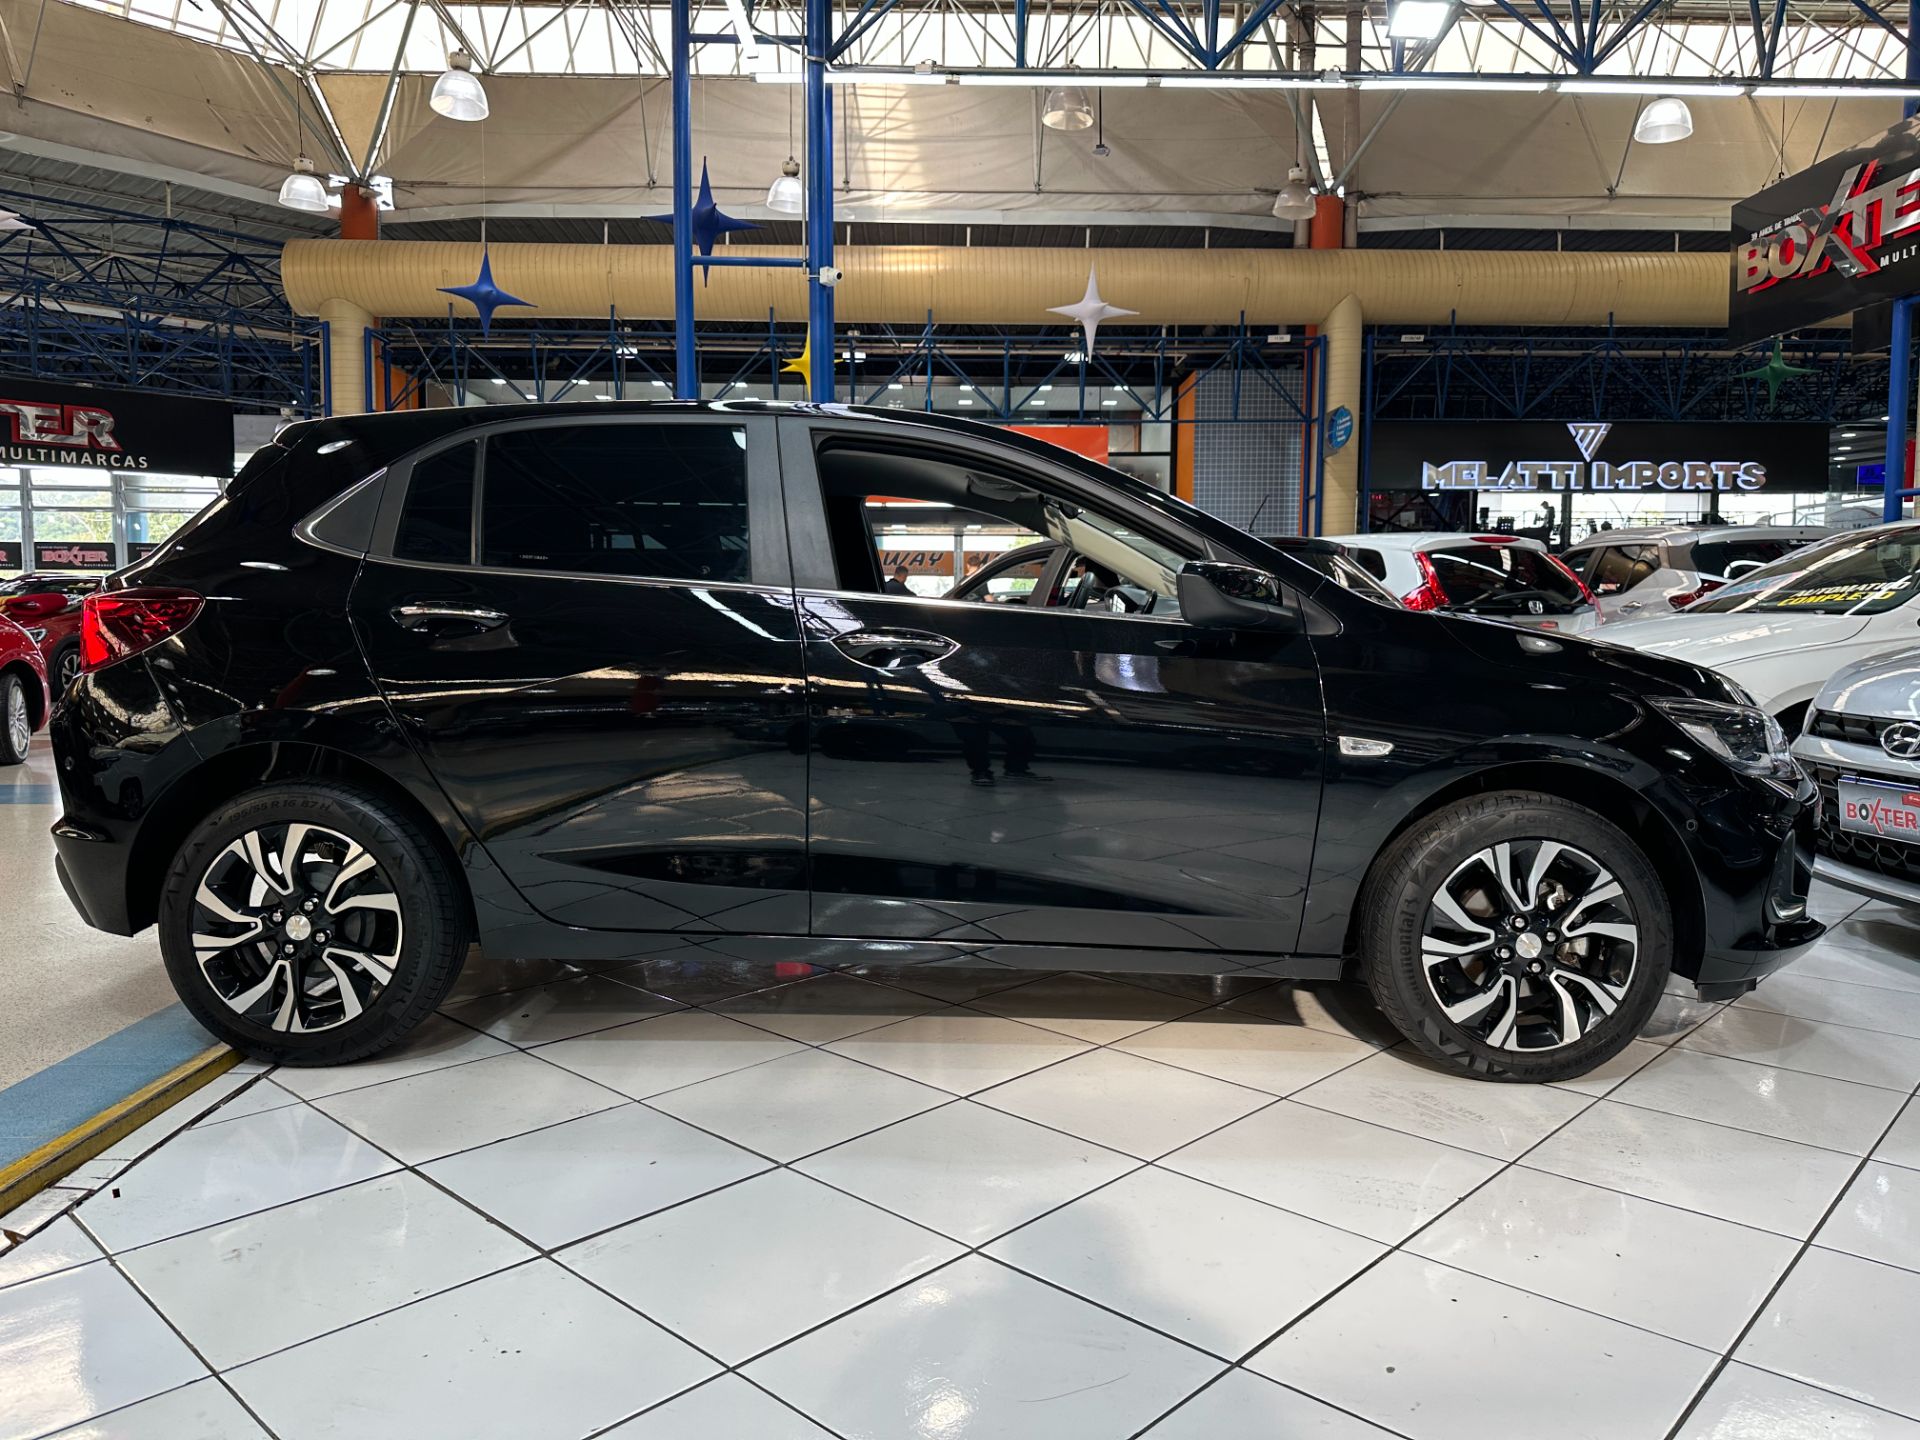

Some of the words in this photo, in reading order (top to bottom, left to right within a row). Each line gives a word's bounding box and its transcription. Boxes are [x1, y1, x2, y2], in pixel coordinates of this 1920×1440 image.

[1774, 220, 1783, 231] DE
[1422, 460, 1585, 490] MELATTI
[1591, 460, 1768, 491] IMPORTS
[41, 546, 109, 566] BOXTER
[883, 552, 944, 566] WAY
[1777, 591, 1897, 607] COMPLETO
[270, 799, 281, 809] R
[1846, 798, 1919, 835] BOXTER
